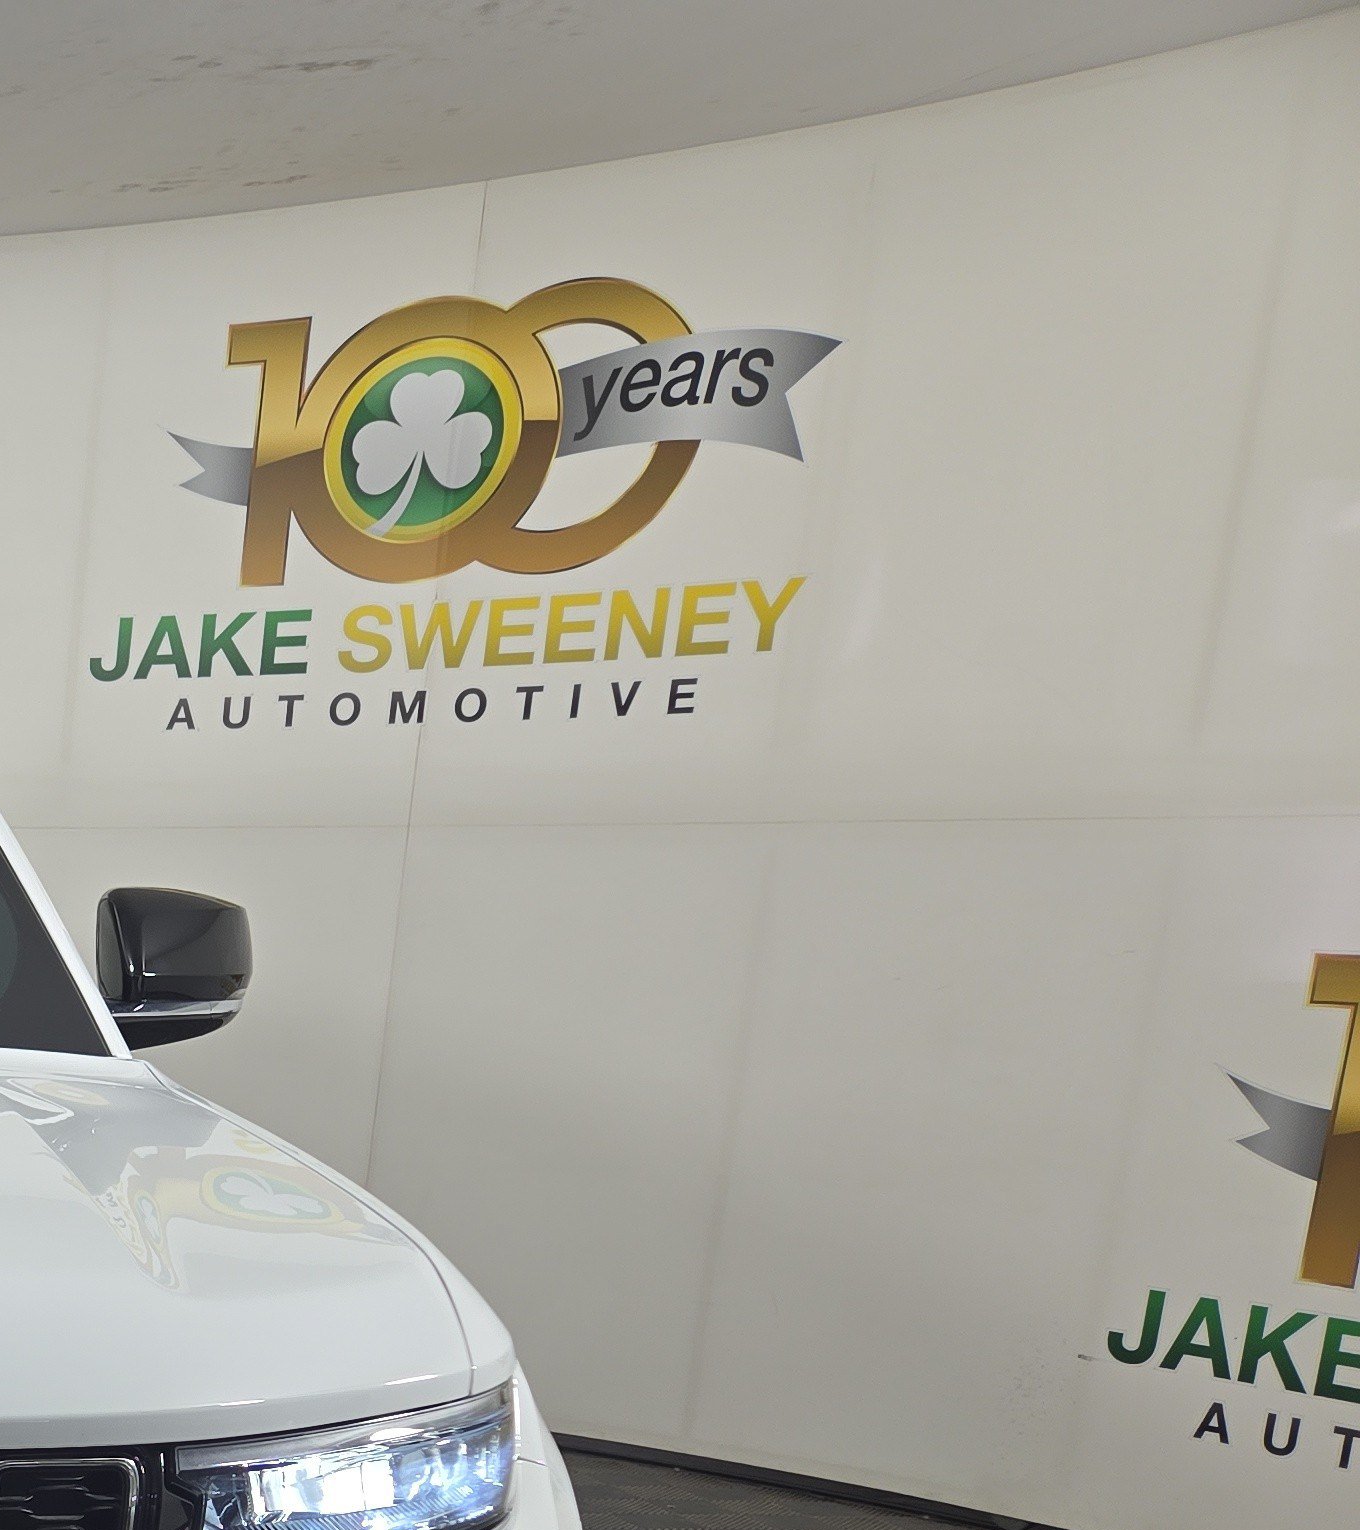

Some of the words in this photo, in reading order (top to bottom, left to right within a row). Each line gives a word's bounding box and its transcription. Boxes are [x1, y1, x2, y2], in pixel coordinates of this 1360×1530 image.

[572, 344, 774, 440] years
[89, 608, 312, 682] JAKE
[337, 577, 808, 674] SWEENEY
[166, 677, 701, 732] AUTOMOTIVE
[1107, 1289, 1360, 1404] JAKE
